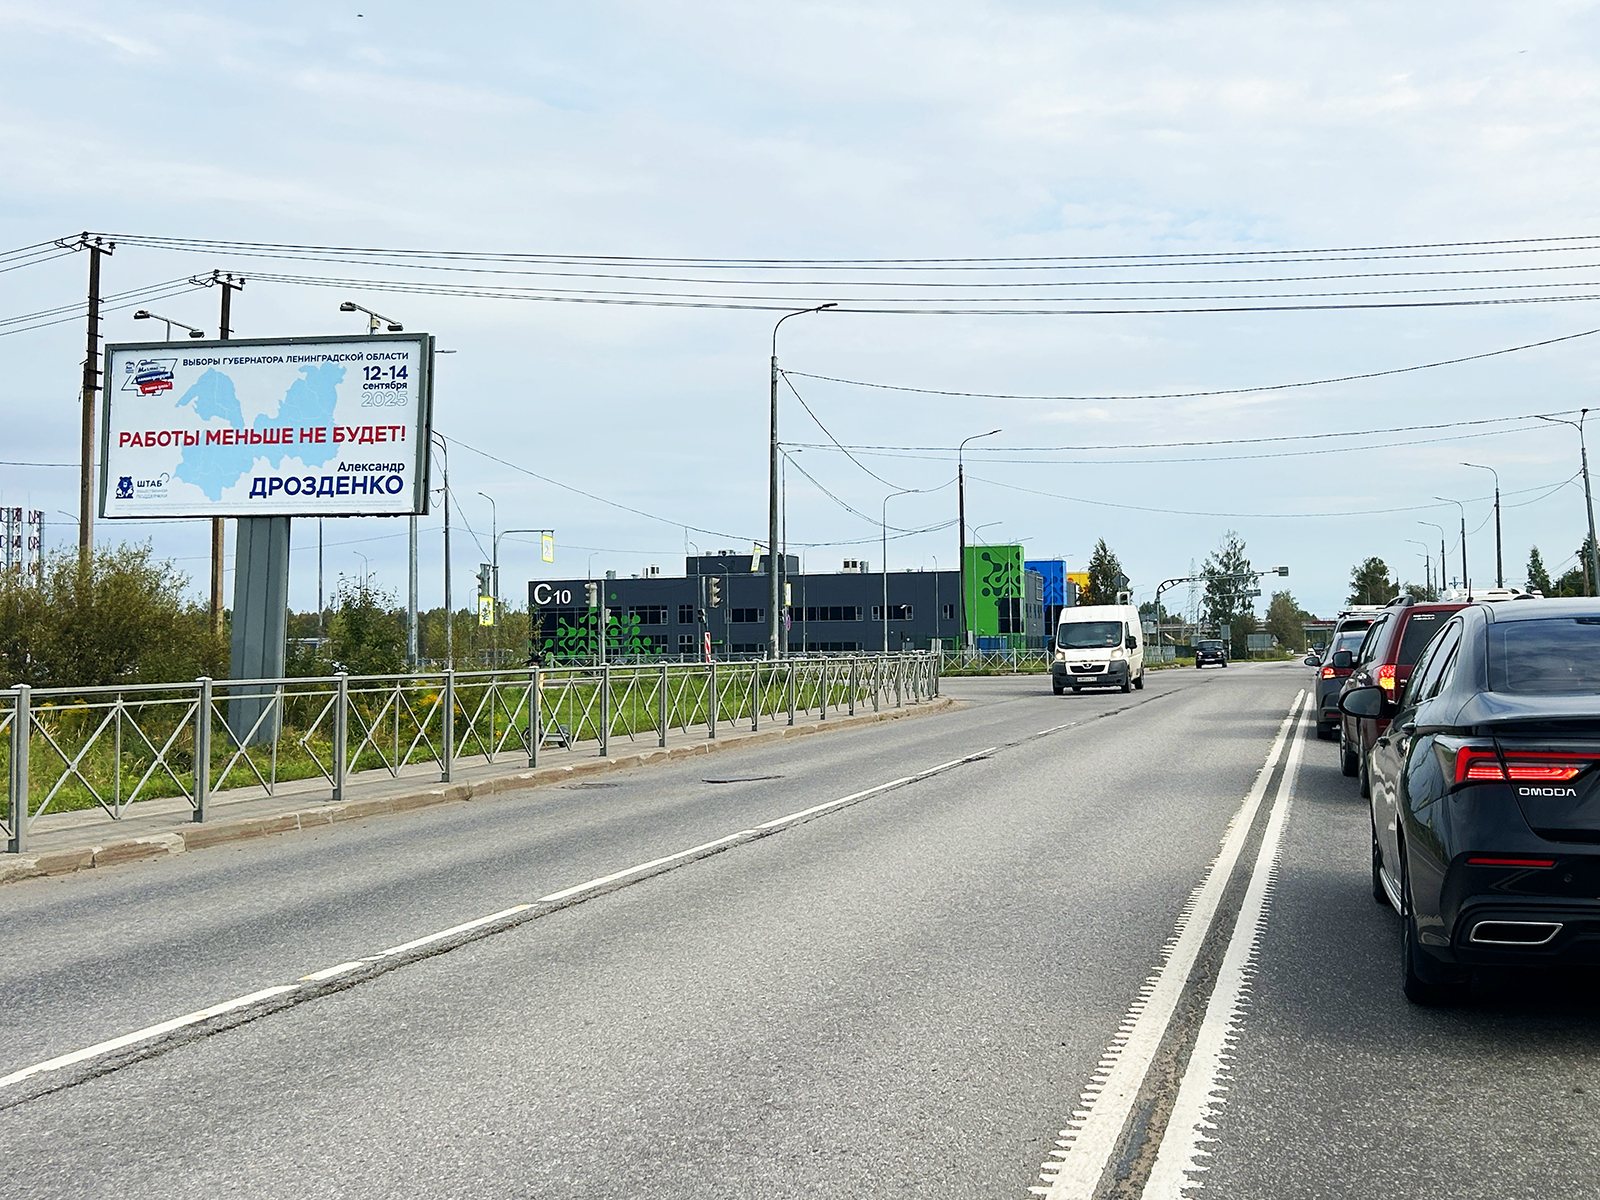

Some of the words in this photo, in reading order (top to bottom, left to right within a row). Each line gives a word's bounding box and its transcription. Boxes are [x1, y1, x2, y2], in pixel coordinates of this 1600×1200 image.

[183, 358, 221, 366] ВЫБОРЫ
[222, 355, 284, 365] ГУБЕРНАТОРА
[285, 352, 364, 363] ЛЕНИНГРАДСКОЙ
[365, 352, 409, 361] ОБЛАСТИ
[363, 365, 409, 380] 12-14
[362, 381, 408, 391] сентября
[361, 391, 409, 407] 2025
[119, 430, 200, 447] РАБОТЫ
[205, 427, 294, 446] МЕНЬШЕ
[299, 426, 327, 443] НЕ
[332, 425, 406, 445] БУДЕТ!
[337, 461, 405, 474] Александр
[136, 479, 163, 488] ШТАБ
[249, 475, 404, 499] ДРОЗДЕНКО
[1519, 787, 1577, 797] OMODA
